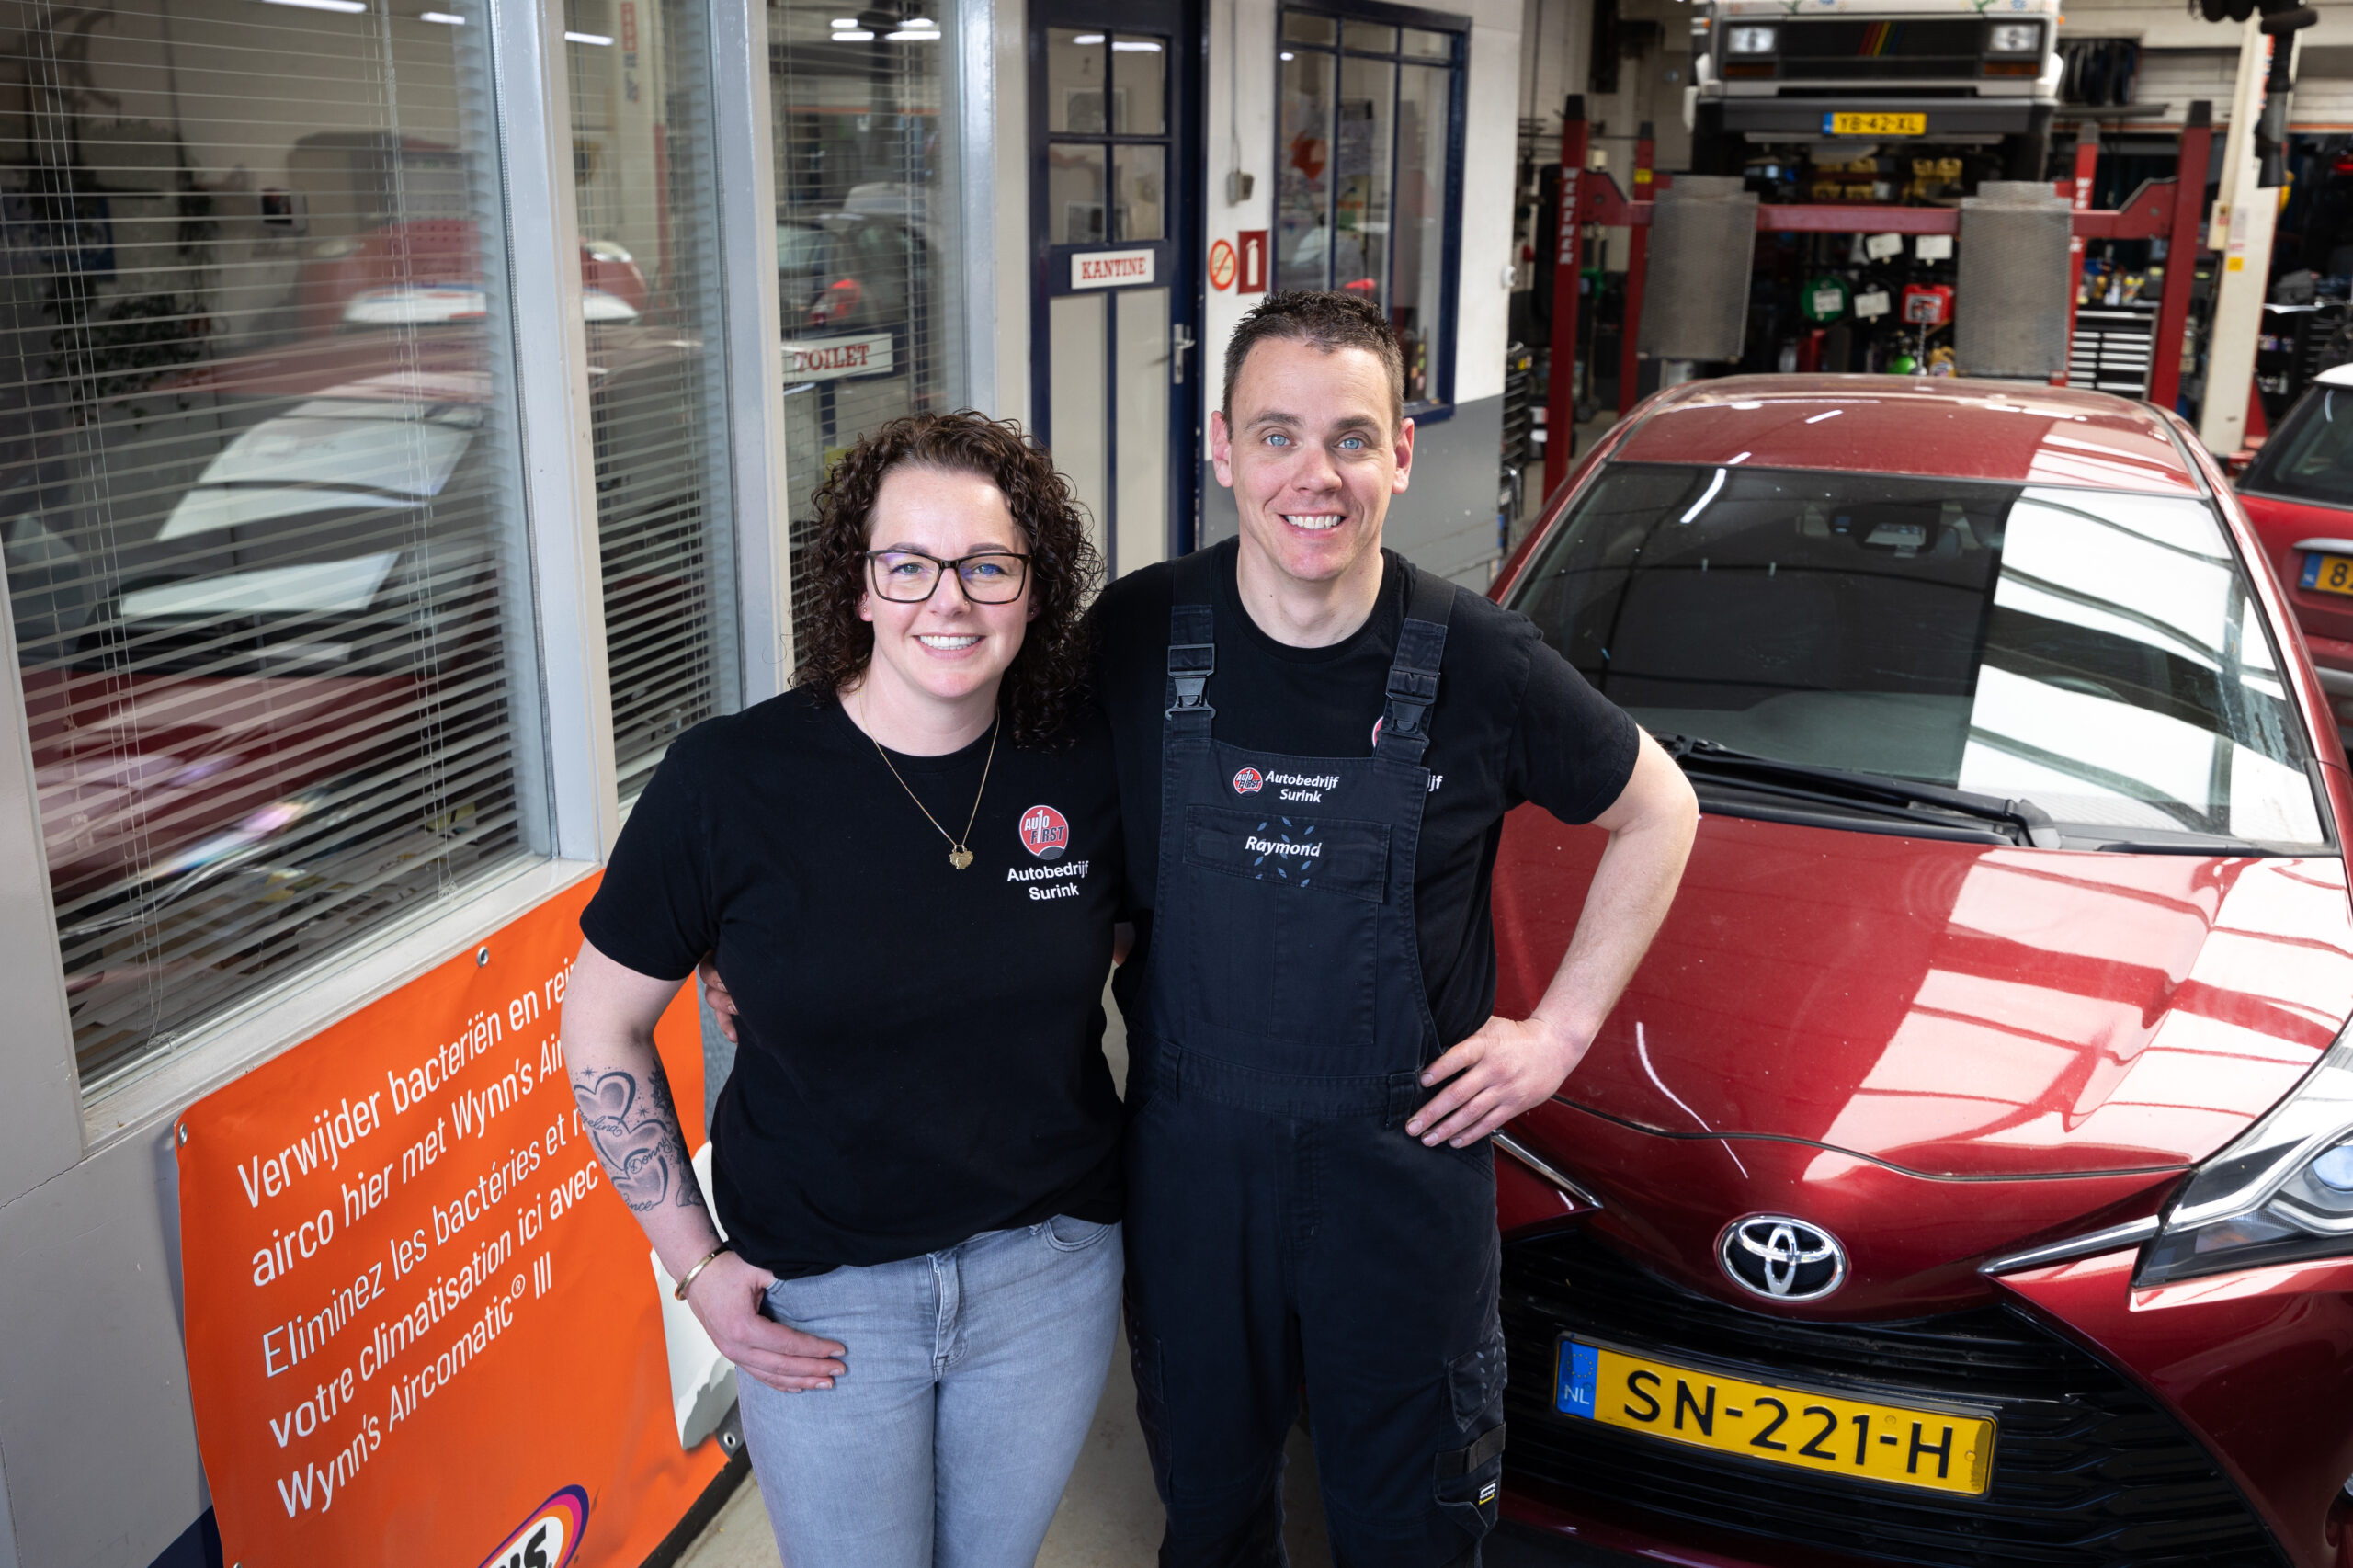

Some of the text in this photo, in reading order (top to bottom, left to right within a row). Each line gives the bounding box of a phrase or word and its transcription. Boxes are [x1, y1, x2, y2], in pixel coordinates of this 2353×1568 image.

[1081, 256, 1147, 280] KANTINE
[793, 344, 870, 373] TOILET
[1265, 770, 1340, 791] Autobedrijf
[1279, 789, 1322, 803] Surink
[1245, 835, 1322, 858] Raymond
[1006, 860, 1089, 882] Autobedrijf
[1029, 882, 1080, 901] Surink
[238, 1091, 381, 1209] Verwijder
[387, 1010, 503, 1115] bacteriën
[508, 990, 540, 1032] en
[252, 1209, 335, 1288] airco
[340, 1162, 394, 1229] hier
[402, 1117, 448, 1185] met
[450, 1058, 534, 1141] Wynn's
[262, 1111, 567, 1380] Eliminez les bactéries et
[269, 1159, 599, 1449] votre climatisation ici avec
[1563, 1385, 1590, 1406] NL
[1623, 1369, 1953, 1480] SN-221-H
[277, 1413, 381, 1519] Wynn's
